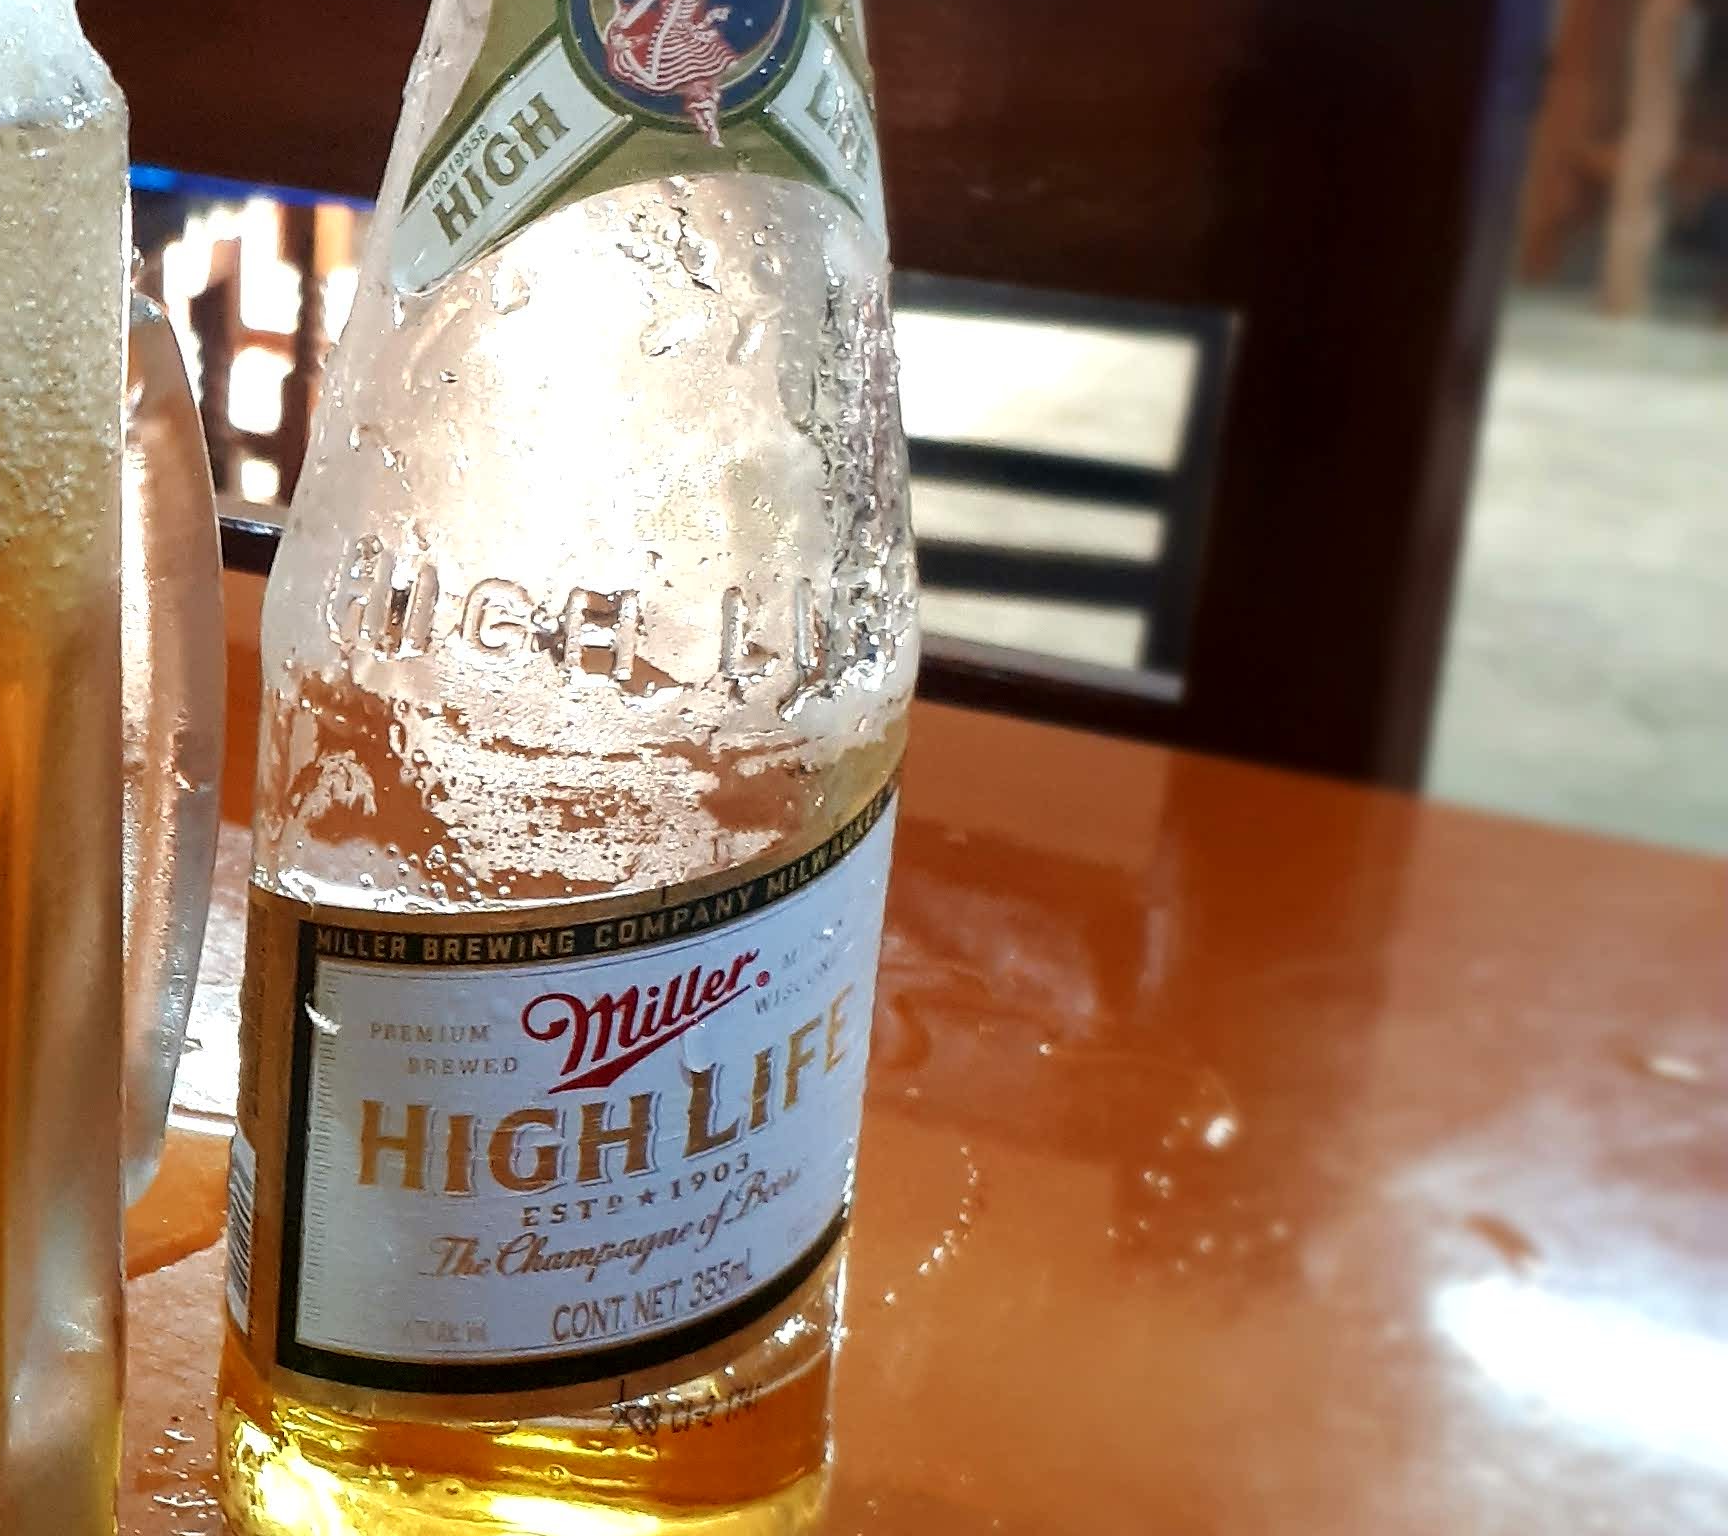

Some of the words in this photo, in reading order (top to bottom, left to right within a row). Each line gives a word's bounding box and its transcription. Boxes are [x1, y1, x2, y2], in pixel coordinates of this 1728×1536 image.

[432, 91, 571, 245] HIGH
[316, 927, 408, 961] MILLER
[422, 930, 577, 961] BREWING
[594, 886, 756, 949] COMPANY
[368, 1022, 492, 1043] PREMIUM
[521, 948, 761, 1096] Miller
[357, 1091, 658, 1200] HIGH
[681, 983, 857, 1159] LIFE
[407, 1056, 519, 1075] BREWED
[670, 1151, 751, 1201] 1903
[419, 1233, 492, 1280] The
[494, 1221, 693, 1283] Champagne
[693, 1188, 733, 1254] of
